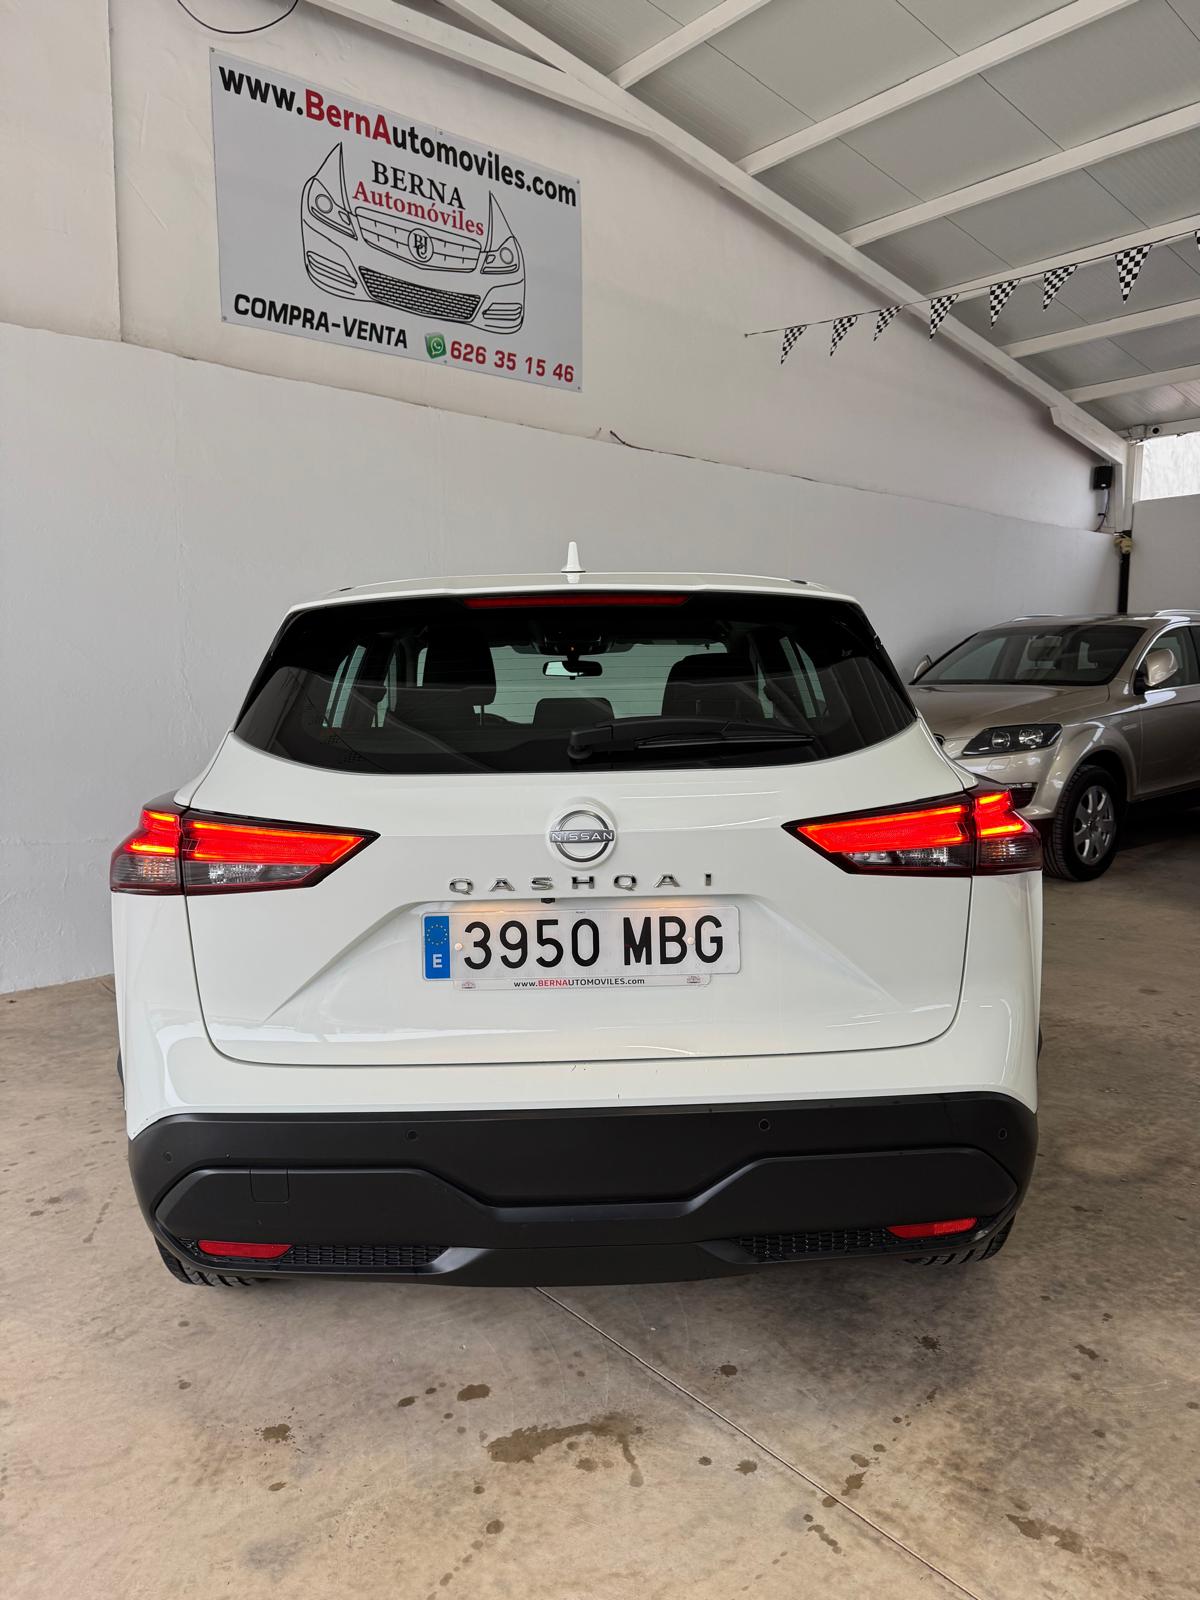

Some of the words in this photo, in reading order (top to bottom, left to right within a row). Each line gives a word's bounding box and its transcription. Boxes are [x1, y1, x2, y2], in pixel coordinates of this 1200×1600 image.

[218, 66, 577, 206] www.BernAutomoviles.com
[371, 160, 466, 210] BERNA
[352, 180, 485, 237] Automóviles
[234, 293, 408, 350] COMPRA-VENTA
[450, 340, 486, 366] 626
[494, 350, 517, 371] 35
[524, 356, 546, 377] 15
[552, 362, 575, 383] 46
[552, 831, 614, 842] NISSAN
[449, 873, 712, 895] QASHQAI
[432, 953, 443, 968] E
[463, 918, 600, 970] 3950
[623, 915, 724, 966] MBG
[513, 976, 646, 989] www.BERNAUTOMOVILES.com
